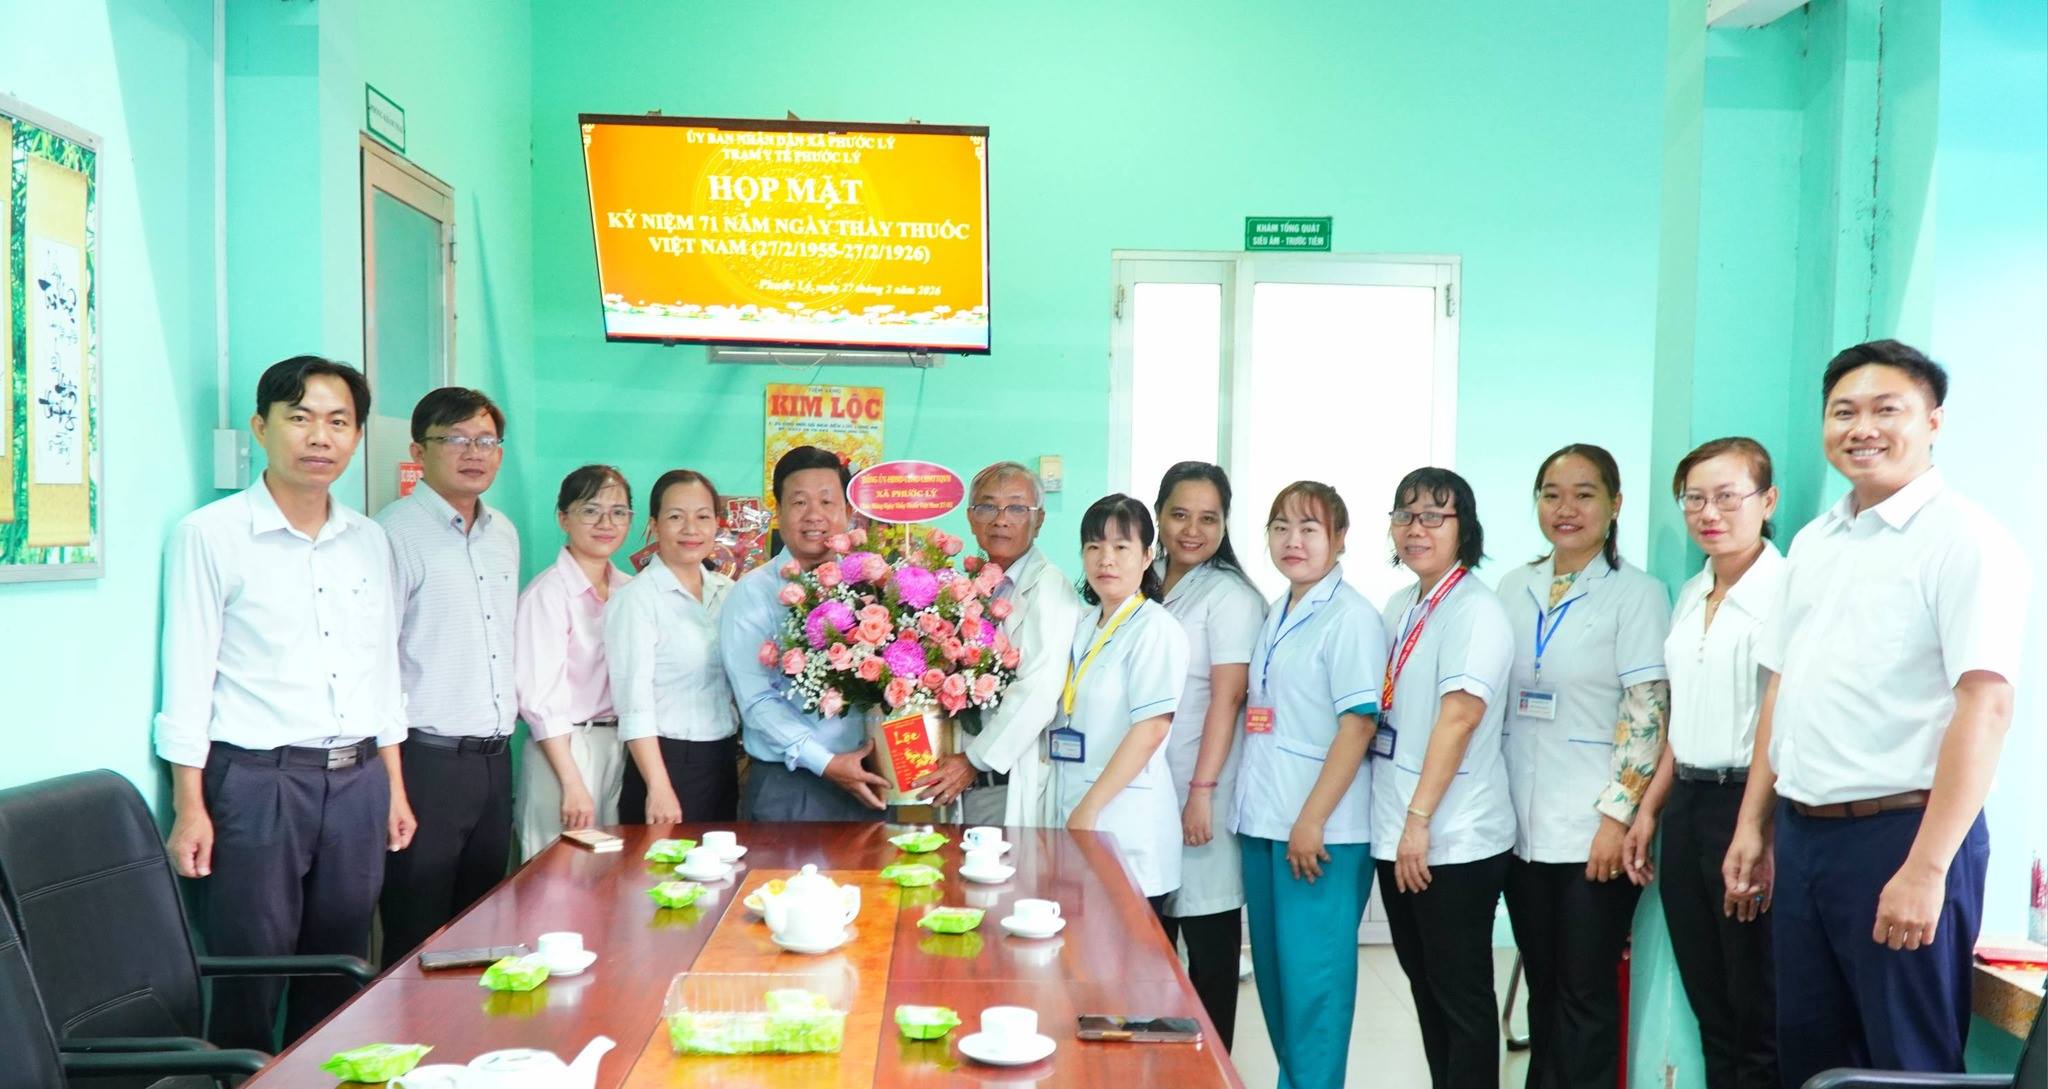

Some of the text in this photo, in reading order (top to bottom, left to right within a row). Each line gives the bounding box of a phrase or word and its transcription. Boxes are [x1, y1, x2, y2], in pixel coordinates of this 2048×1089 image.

[707, 131, 734, 145] BAN
[736, 131, 774, 147] NHÂN
[776, 132, 804, 150] DÂN
[806, 134, 826, 148] XÃ
[877, 134, 896, 151] LÝ
[761, 149, 771, 163] Y
[774, 148, 794, 164] TẾ
[843, 150, 862, 165] LÝ
[708, 174, 863, 211] HỌP MẶT
[641, 211, 695, 234] NIỆM
[699, 214, 721, 232] 71
[723, 213, 771, 235] NĂM
[774, 214, 833, 237] NGÀY
[896, 217, 971, 240] THUỐC
[1256, 222, 1279, 233] KHÁM
[1301, 221, 1320, 234] QUÁT
[648, 235, 697, 257] VIỆT
[700, 238, 749, 256] NAM
[1269, 234, 1280, 246] ÂM
[855, 283, 885, 296] tháng
[894, 285, 916, 296] năm
[917, 285, 942, 296] 2026
[771, 393, 881, 425] KIM LỘC
